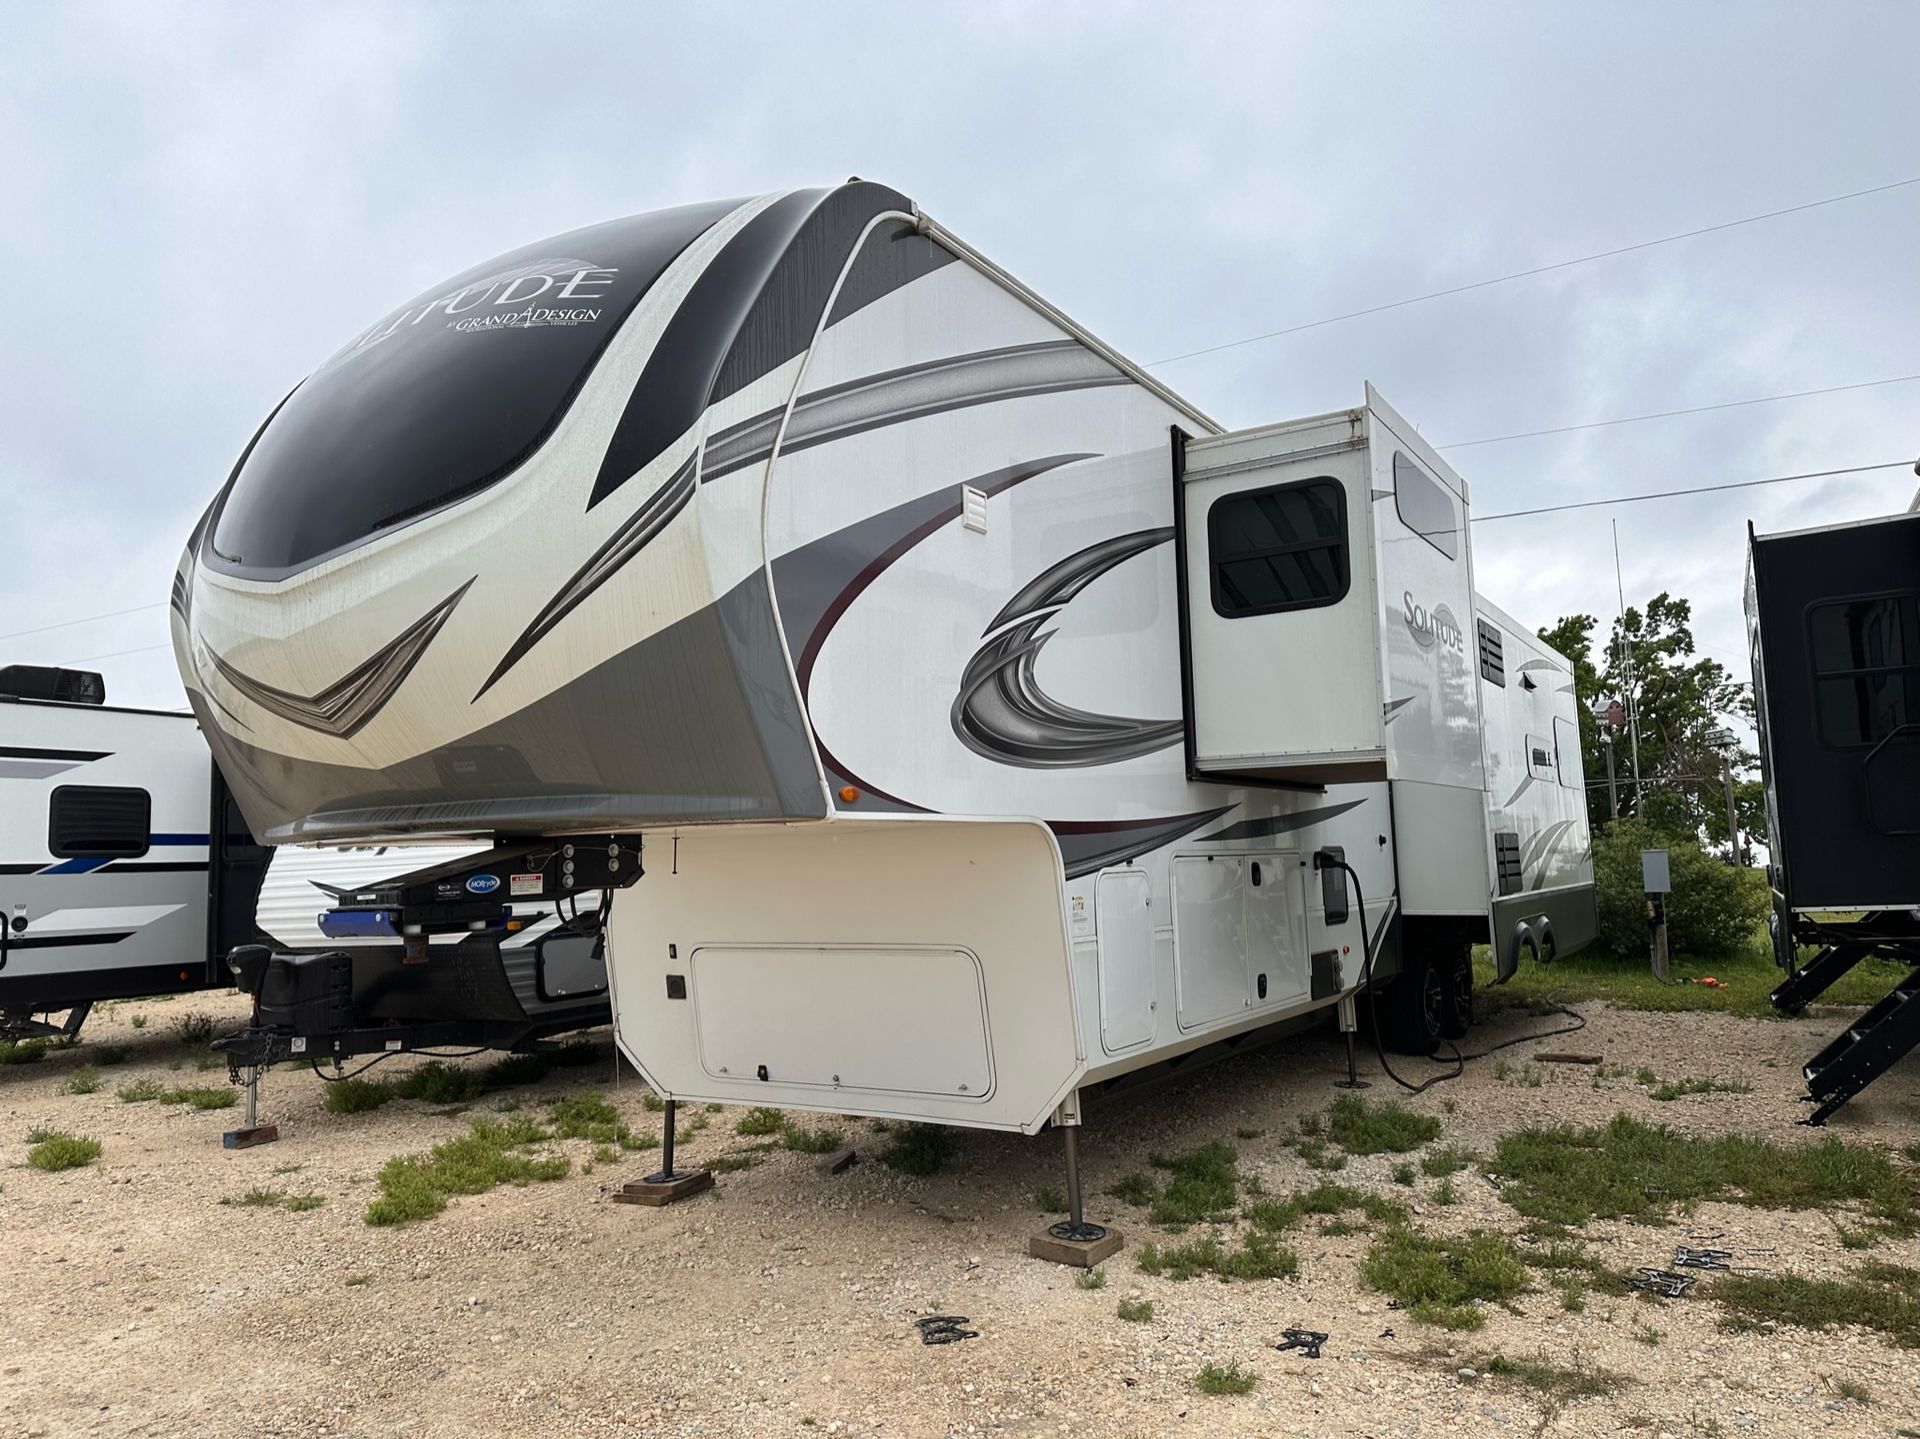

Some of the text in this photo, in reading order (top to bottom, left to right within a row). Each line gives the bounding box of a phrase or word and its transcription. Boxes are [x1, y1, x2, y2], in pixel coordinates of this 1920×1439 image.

[341, 267, 619, 356] LITUDE
[456, 312, 519, 331] GRAND
[531, 308, 602, 321] DESIGN
[1403, 590, 1464, 654] SOLITUDE
